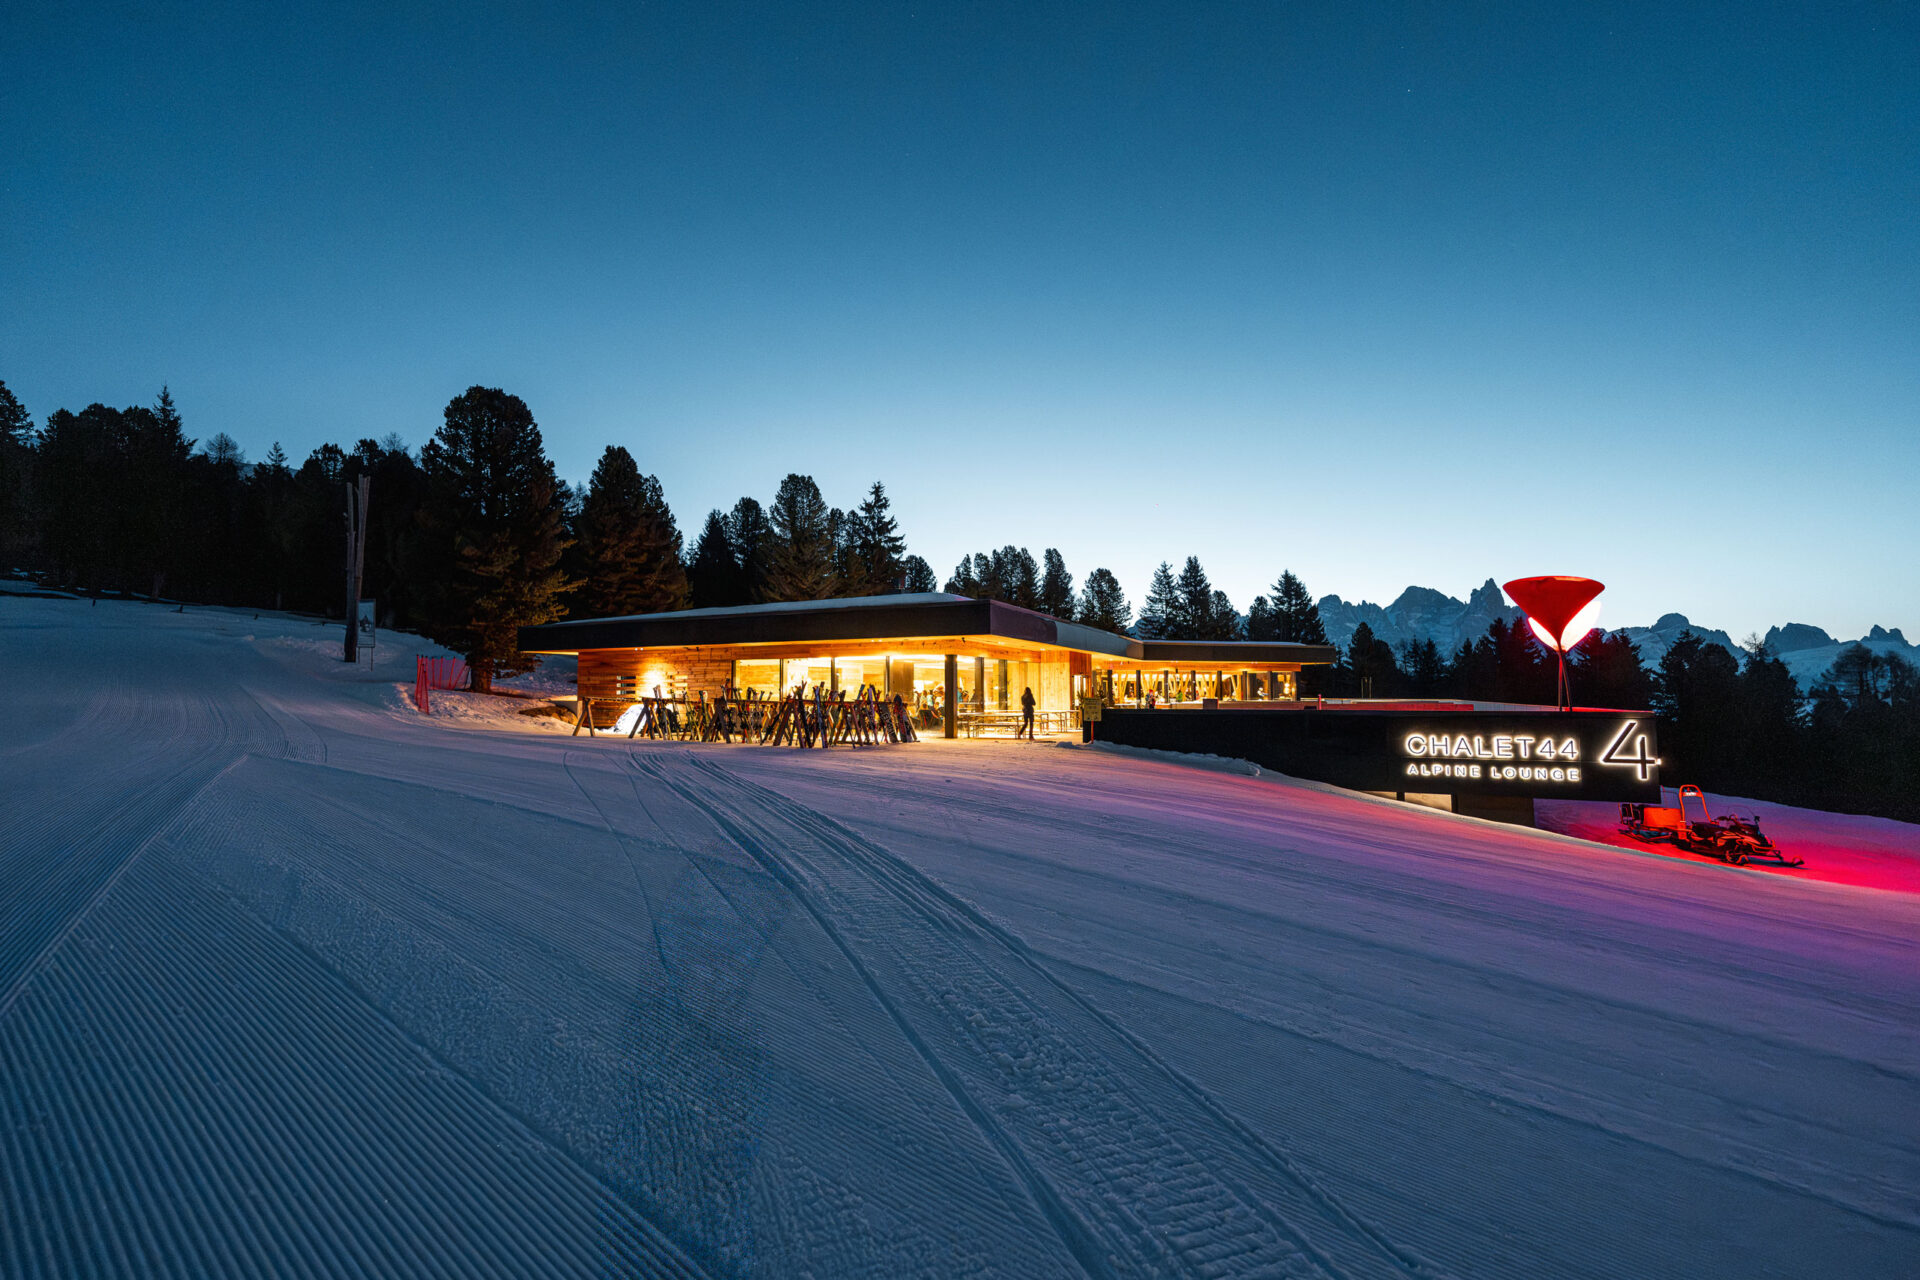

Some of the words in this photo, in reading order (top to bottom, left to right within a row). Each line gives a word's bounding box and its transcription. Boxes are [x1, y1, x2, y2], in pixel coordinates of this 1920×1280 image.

[1405, 733, 1579, 760] CHALET44
[1407, 763, 1481, 778] ALPINE
[1490, 765, 1580, 781] LOUNGE
